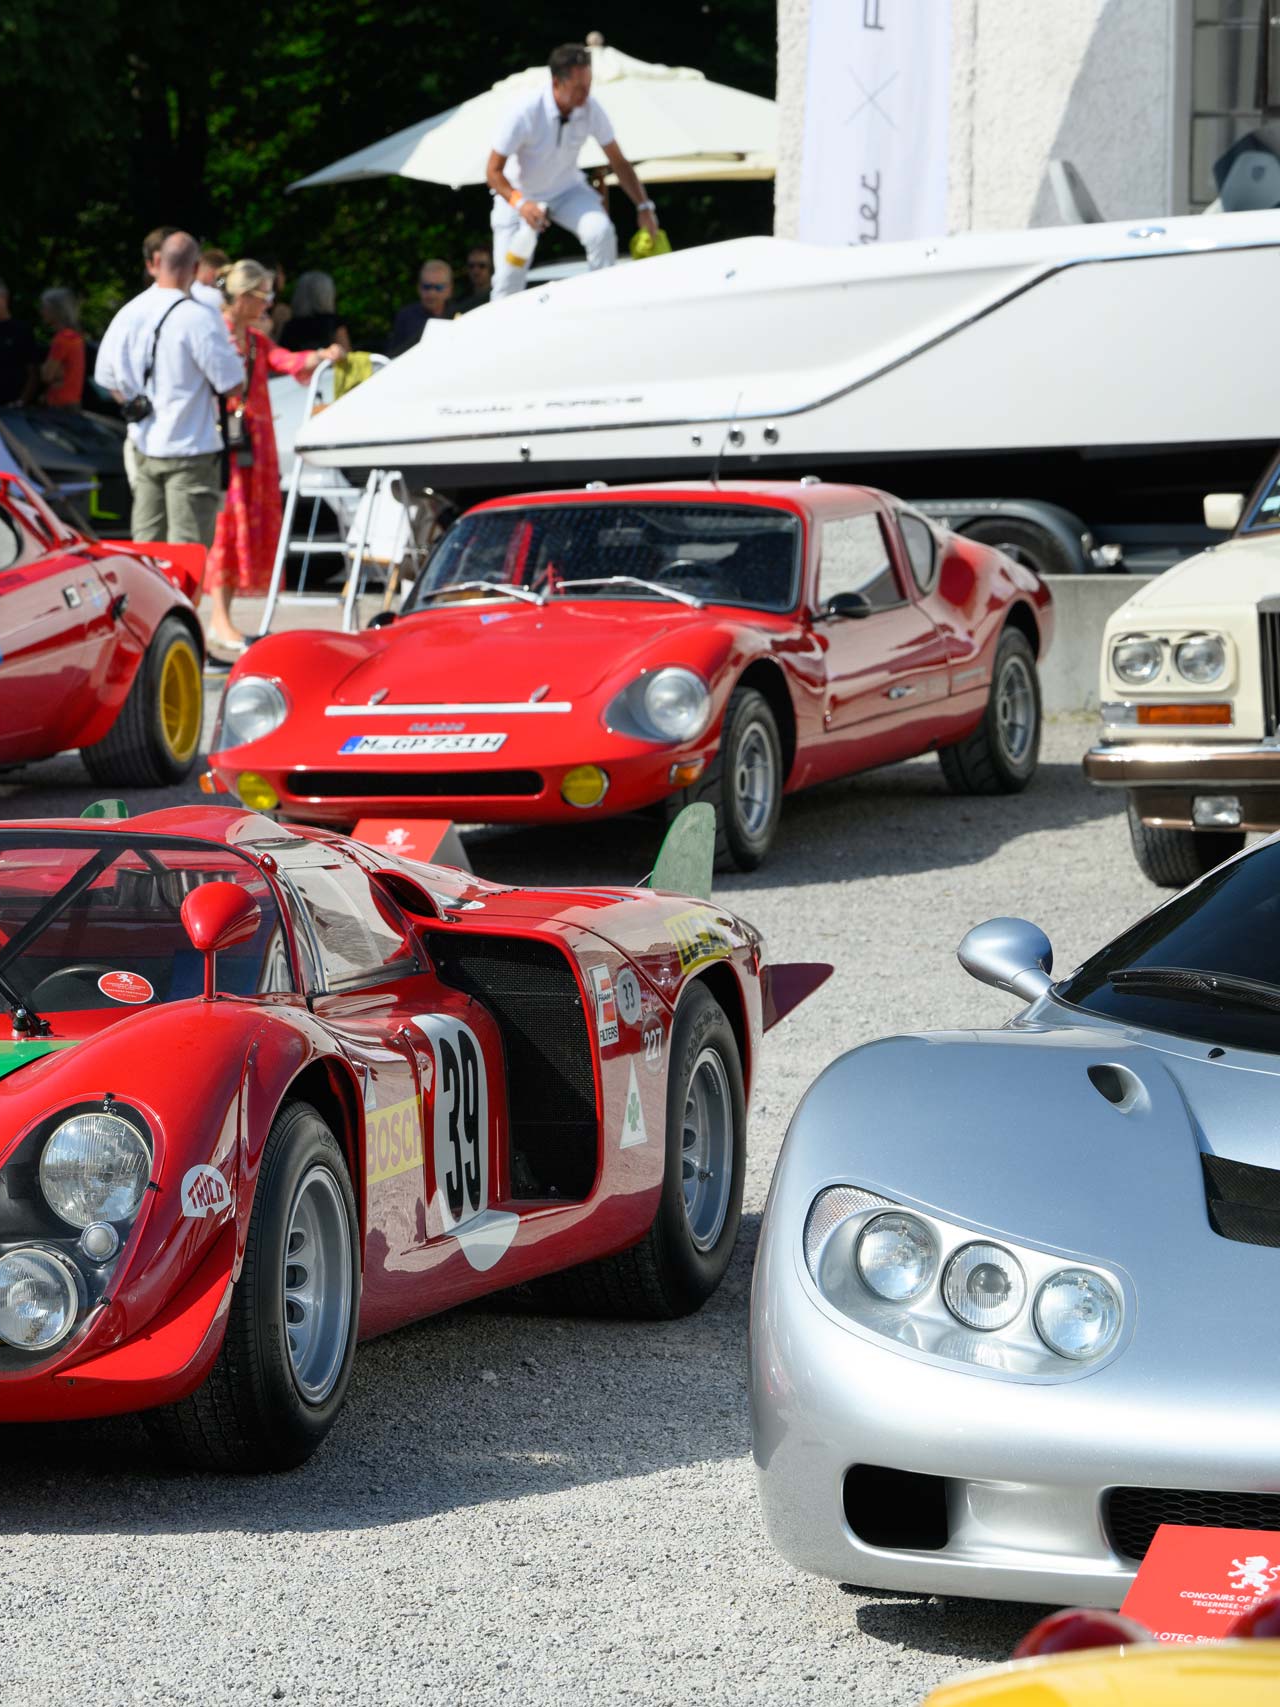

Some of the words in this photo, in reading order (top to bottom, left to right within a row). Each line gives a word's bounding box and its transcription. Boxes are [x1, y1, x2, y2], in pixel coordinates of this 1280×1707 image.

[622, 981, 636, 1011] 33
[643, 1027, 663, 1062] 227
[367, 1105, 424, 1176] BOSCH
[438, 1029, 482, 1224] 39
[187, 1171, 225, 1210] TRICO
[1180, 1591, 1235, 1601] CONCOURS
[1236, 1595, 1252, 1603] OF
[1192, 1600, 1239, 1609] TEGERNSEE
[1153, 1631, 1195, 1643] LOTEC
